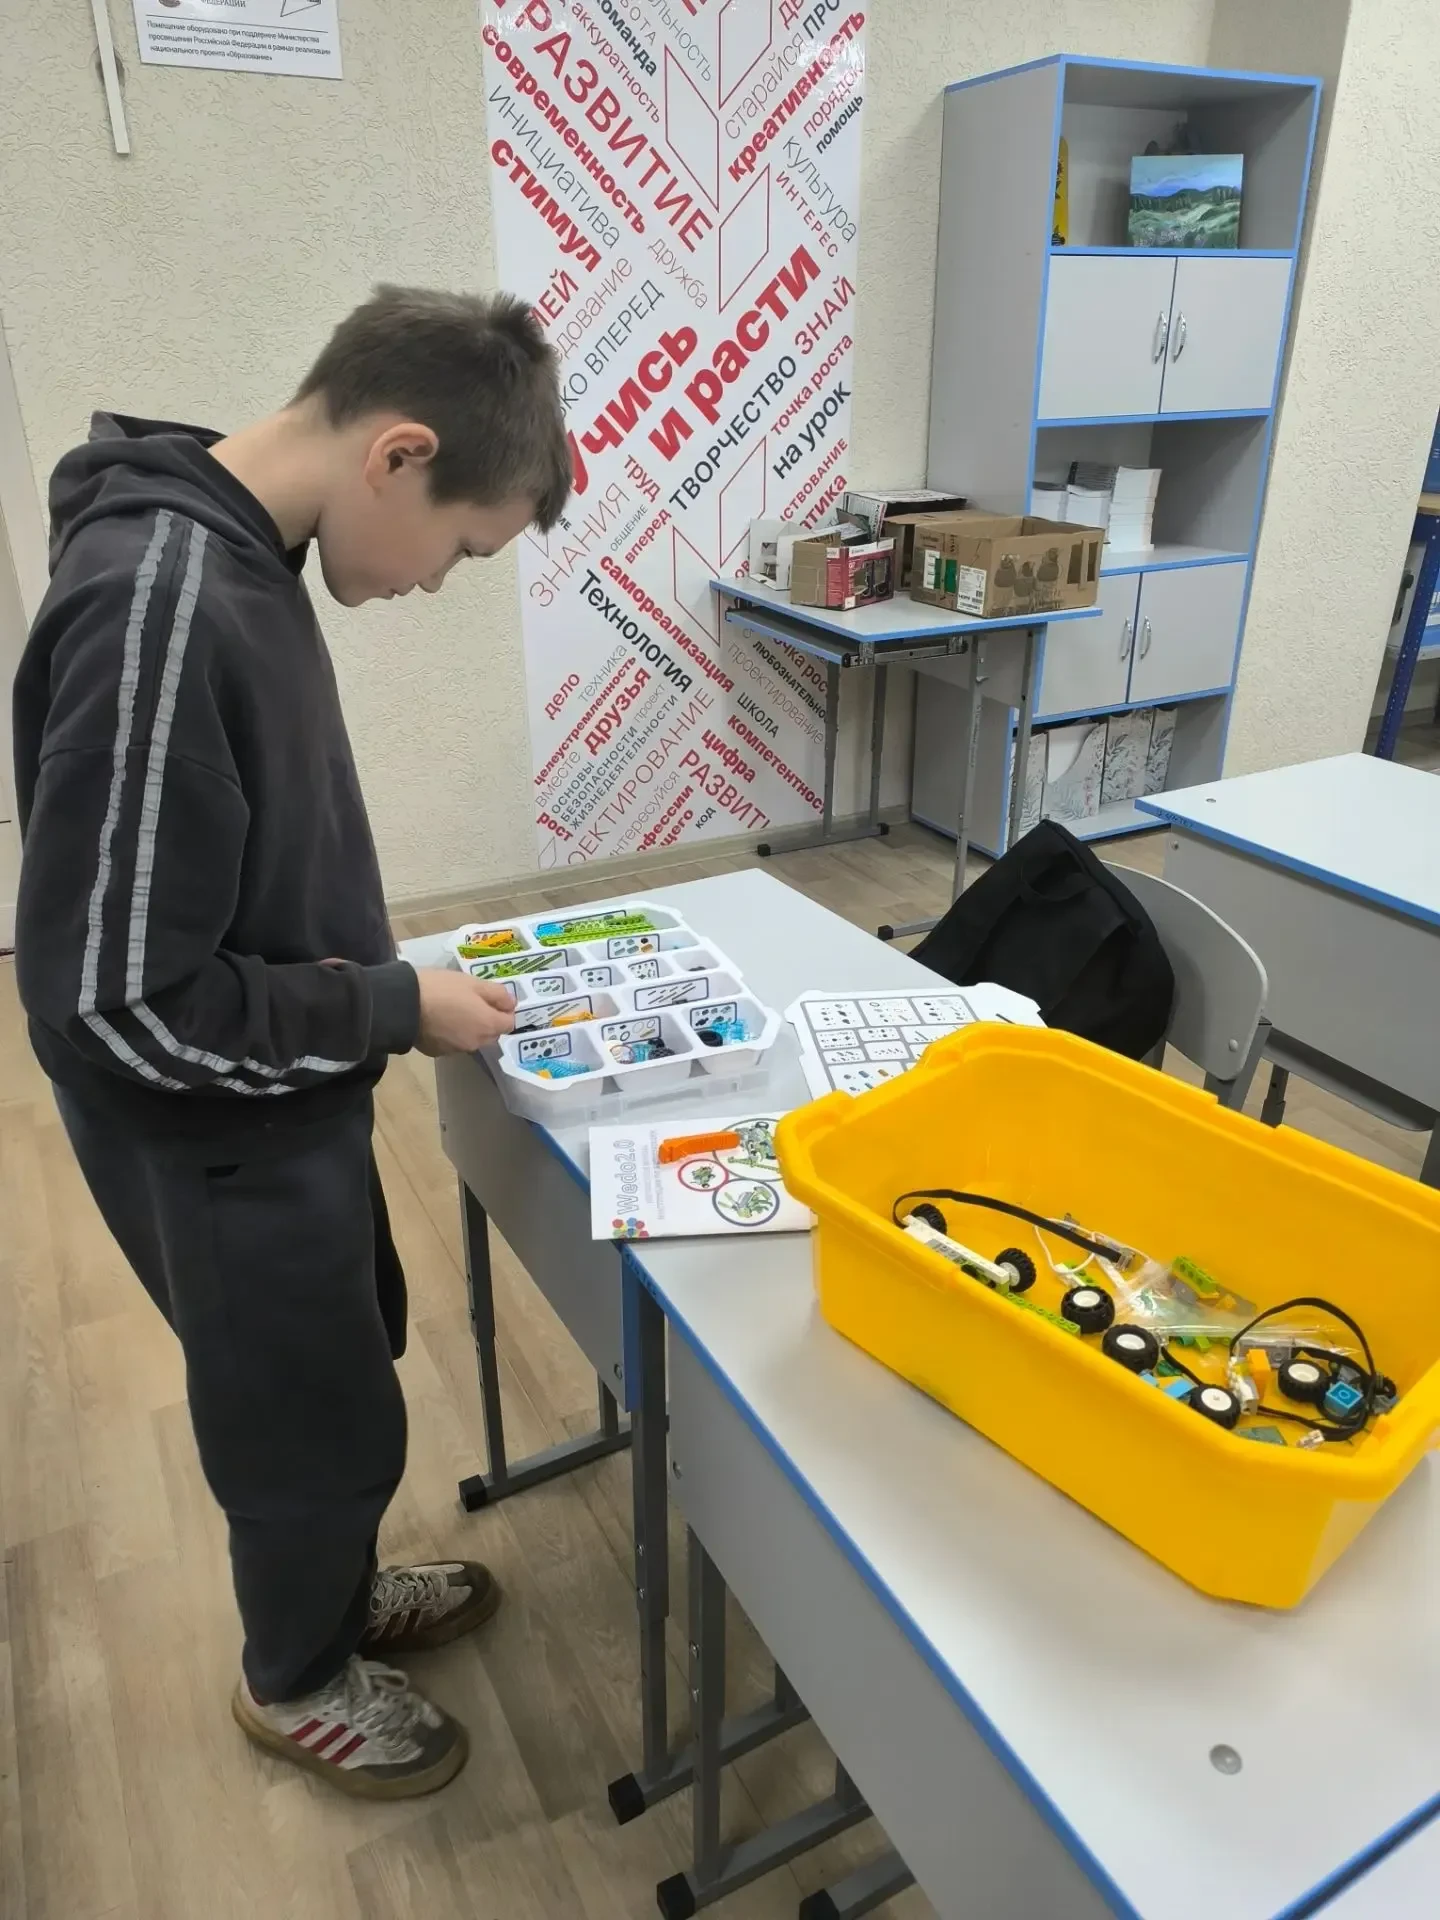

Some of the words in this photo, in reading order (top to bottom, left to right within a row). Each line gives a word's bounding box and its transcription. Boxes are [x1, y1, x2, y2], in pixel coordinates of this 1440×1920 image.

[147, 20, 186, 31] Помещение
[187, 25, 228, 36] оборудовано
[194, 36, 231, 46] Российской
[572, 2, 660, 123] аккуратность
[482, 24, 647, 234] современность
[515, 0, 713, 252] РАЗВИТИЕ
[725, 33, 807, 139] старайся
[728, 12, 866, 183] креативность
[803, 64, 864, 138] порядок
[816, 96, 863, 154] помощь
[488, 84, 621, 249] инициатива
[491, 139, 602, 273] стимул
[782, 136, 857, 243] культура
[776, 171, 839, 259] ИНТЕРЕС
[648, 238, 708, 310] дружба
[795, 275, 856, 356] ЗНАЙ
[584, 280, 665, 375] ВПЕРЕД
[648, 405, 694, 462] и
[684, 244, 821, 425] расти
[771, 386, 813, 436] точка
[811, 335, 853, 391] роста
[669, 356, 797, 511] ТВОРЧЕСТВО
[773, 443, 803, 480] на
[798, 381, 851, 452] урок
[624, 454, 661, 503] труд
[780, 438, 848, 522] СТВОВАНИЕ
[529, 483, 630, 607] ЗНАНИЯ
[610, 504, 649, 552] ОБЩЕНИЕ
[624, 508, 672, 564] вперед
[579, 569, 693, 693] Технология
[600, 556, 735, 693] самореализация
[544, 673, 580, 721] дело
[578, 645, 627, 703] техника
[584, 667, 652, 757] друзья
[633, 683, 666, 724] проект
[727, 641, 824, 745] проектирование
[737, 692, 780, 739] ШКОЛА
[753, 640, 827, 723] ЛЮБОЗНАТЕЛЬНО
[534, 656, 636, 786] целеустремленность
[570, 694, 678, 830] ЖИЗНЕДЕЯТЕЛЬНОСТИ
[701, 729, 756, 783] цифра
[535, 751, 581, 808] вместе
[551, 761, 595, 814] ОСНОВЫ
[561, 726, 638, 823] БЕЗОПАСНОСТИ
[609, 770, 680, 857] нтересуйся
[695, 807, 717, 829] код
[536, 812, 574, 842] рост
[613, 1138, 640, 1216] Wedo2.0
